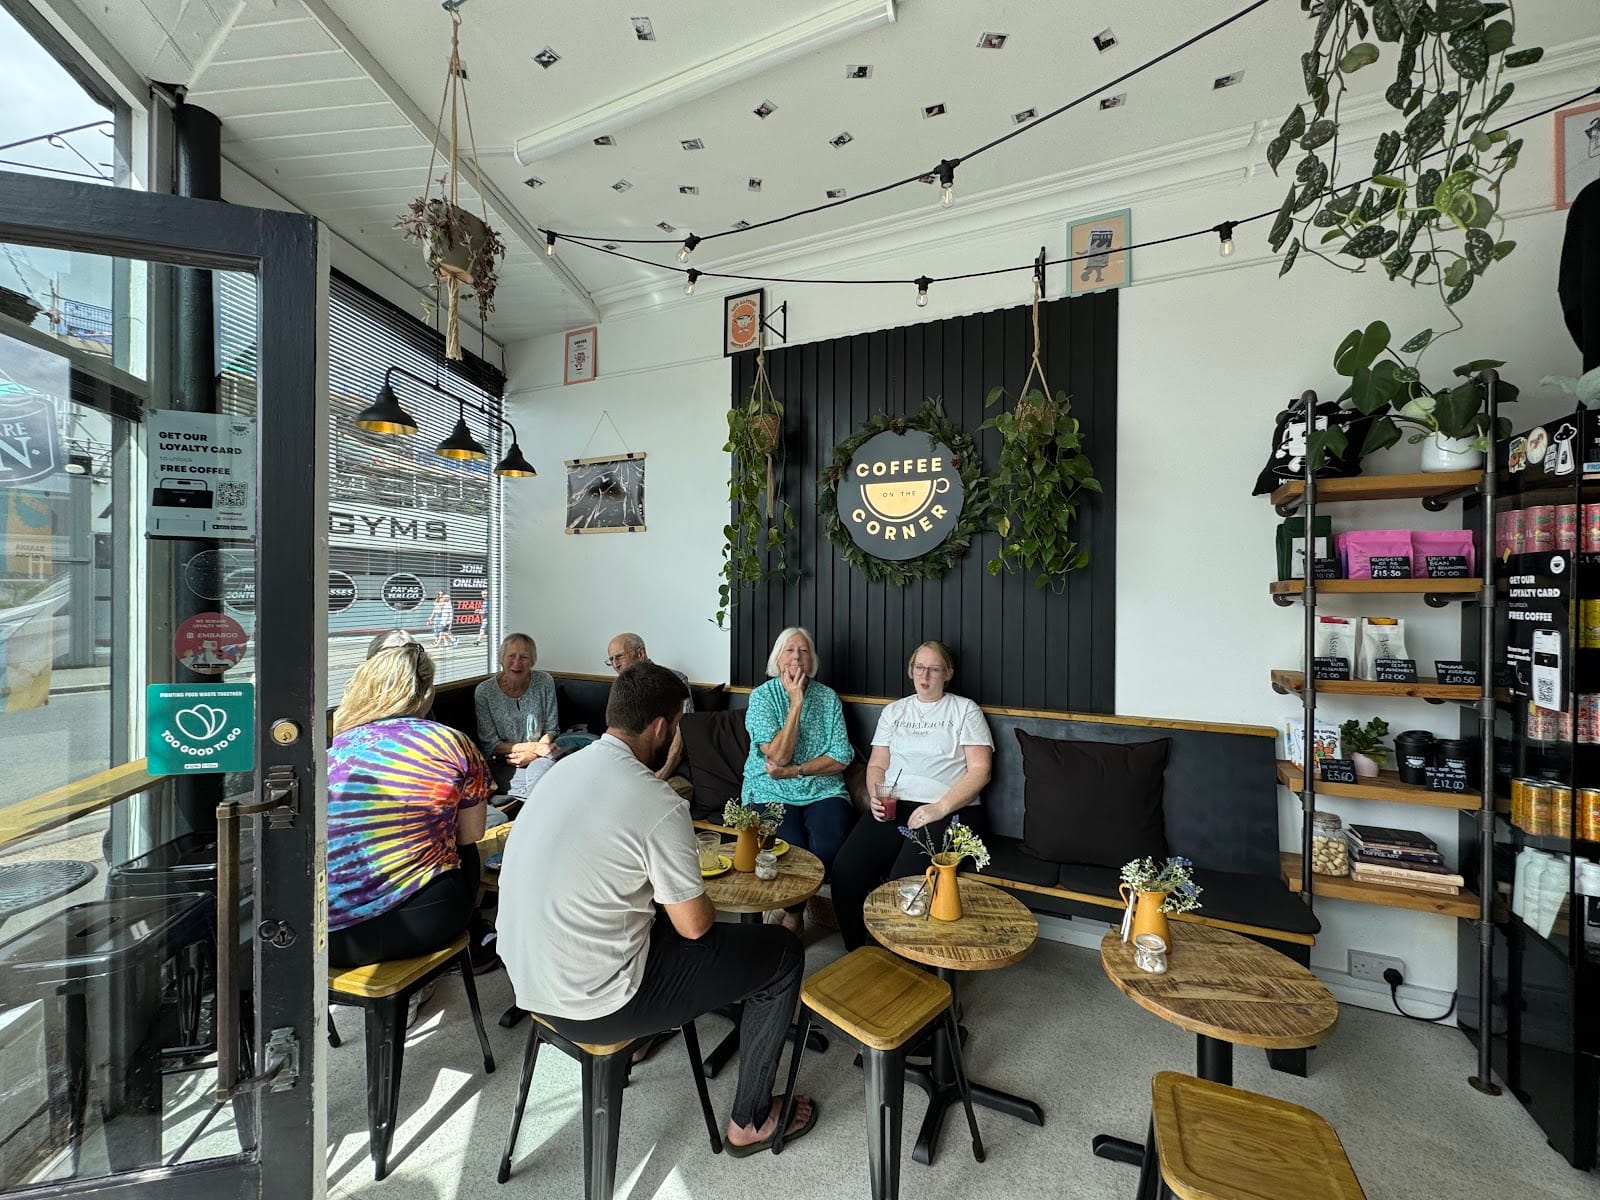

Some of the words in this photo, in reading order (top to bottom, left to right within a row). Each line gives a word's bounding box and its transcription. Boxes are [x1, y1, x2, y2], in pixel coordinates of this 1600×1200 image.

[0, 422, 28, 437] RE
[159, 431, 181, 440] GET
[183, 433, 208, 442] OUR
[160, 443, 208, 453] LOYALTY
[210, 446, 242, 455] CARD
[160, 464, 187, 473] FREE
[189, 466, 231, 475] COFFEE
[856, 457, 942, 477] COFFEE
[328, 511, 447, 541] GYMS
[852, 503, 948, 541] CORNER
[460, 563, 484, 574] JOIN
[453, 577, 488, 588] ONLINE
[1509, 575, 1520, 584] GET
[1521, 575, 1535, 584] OUR
[328, 588, 354, 596] SSES
[1509, 588, 1536, 598] LOYALTY
[1537, 587, 1561, 598] CARD
[456, 614, 483, 624] TODA
[1508, 611, 1524, 620] FREE
[1525, 611, 1552, 621] COFFEE
[161, 730, 180, 748] TOO
[180, 745, 214, 756] GOOD
[213, 740, 229, 751] TO
[227, 727, 241, 741] GO
